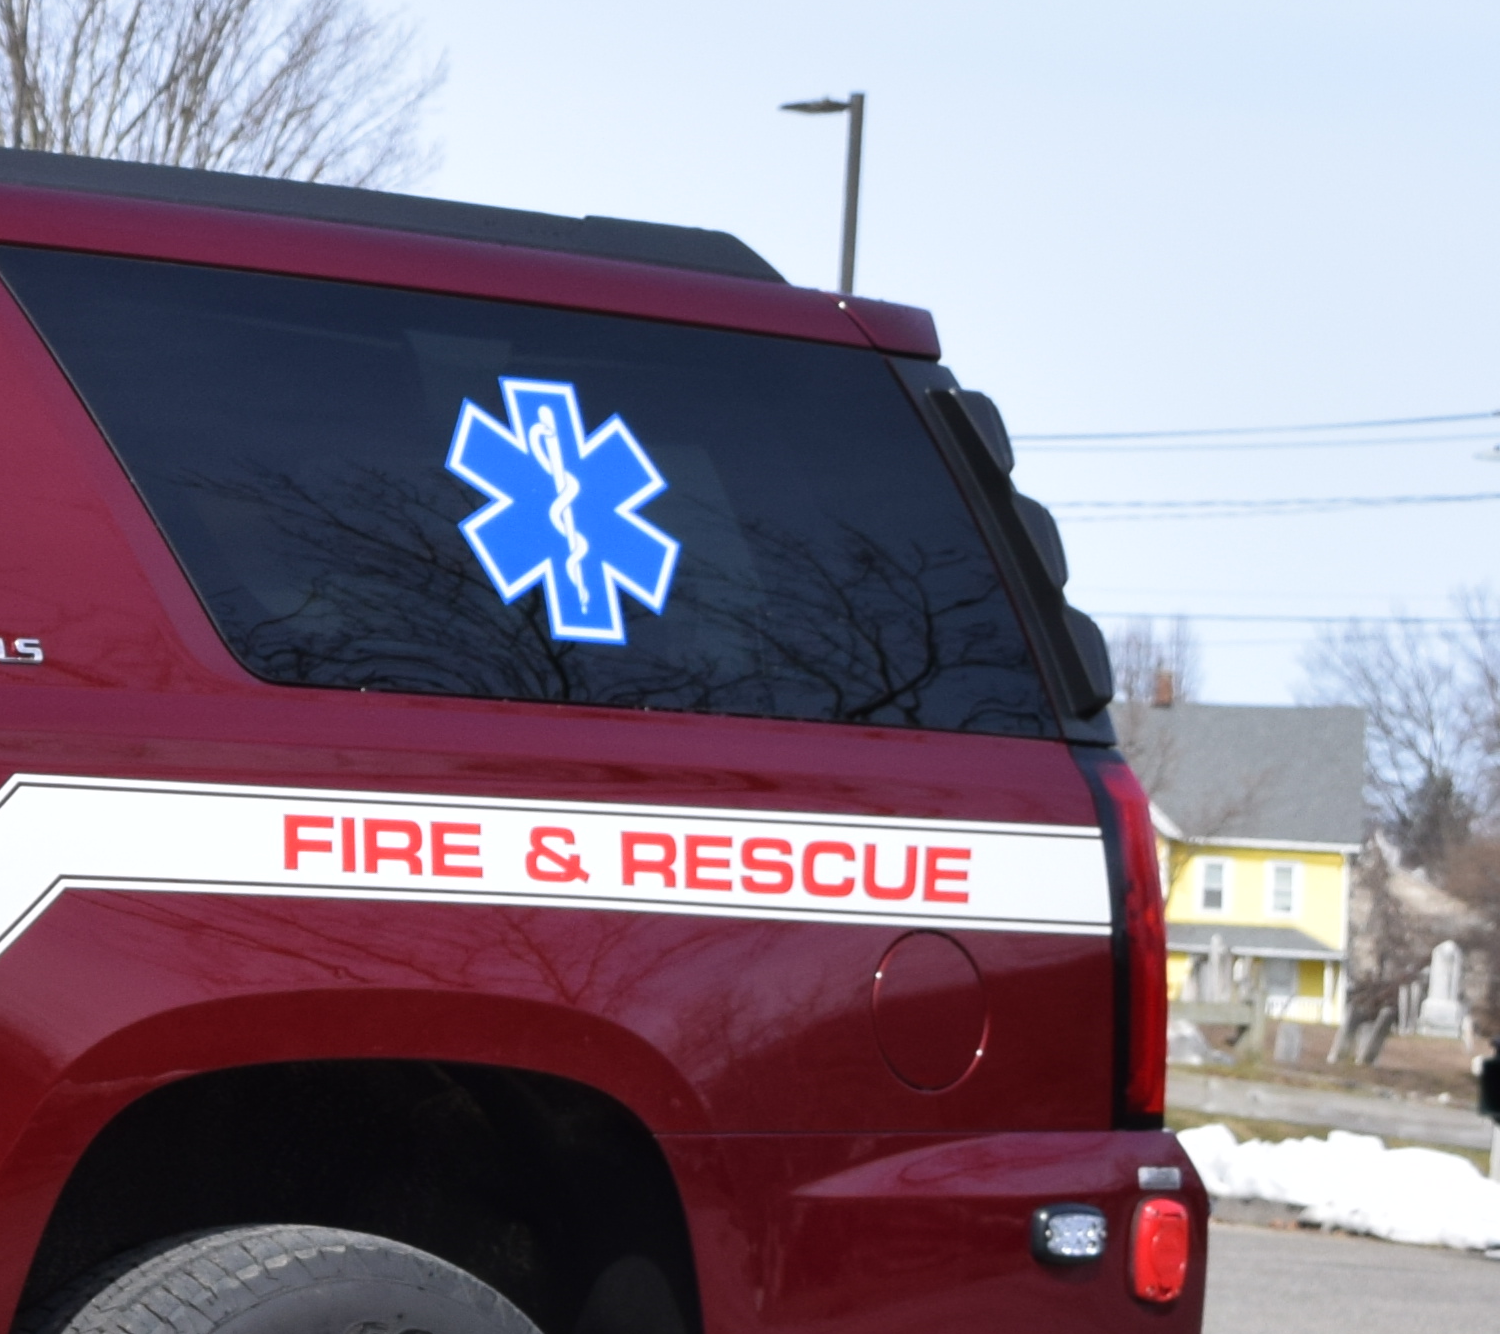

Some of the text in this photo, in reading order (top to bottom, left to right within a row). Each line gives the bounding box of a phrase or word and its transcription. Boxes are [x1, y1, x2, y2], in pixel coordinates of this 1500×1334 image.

[282, 813, 972, 904] FIRE & RESCUE
